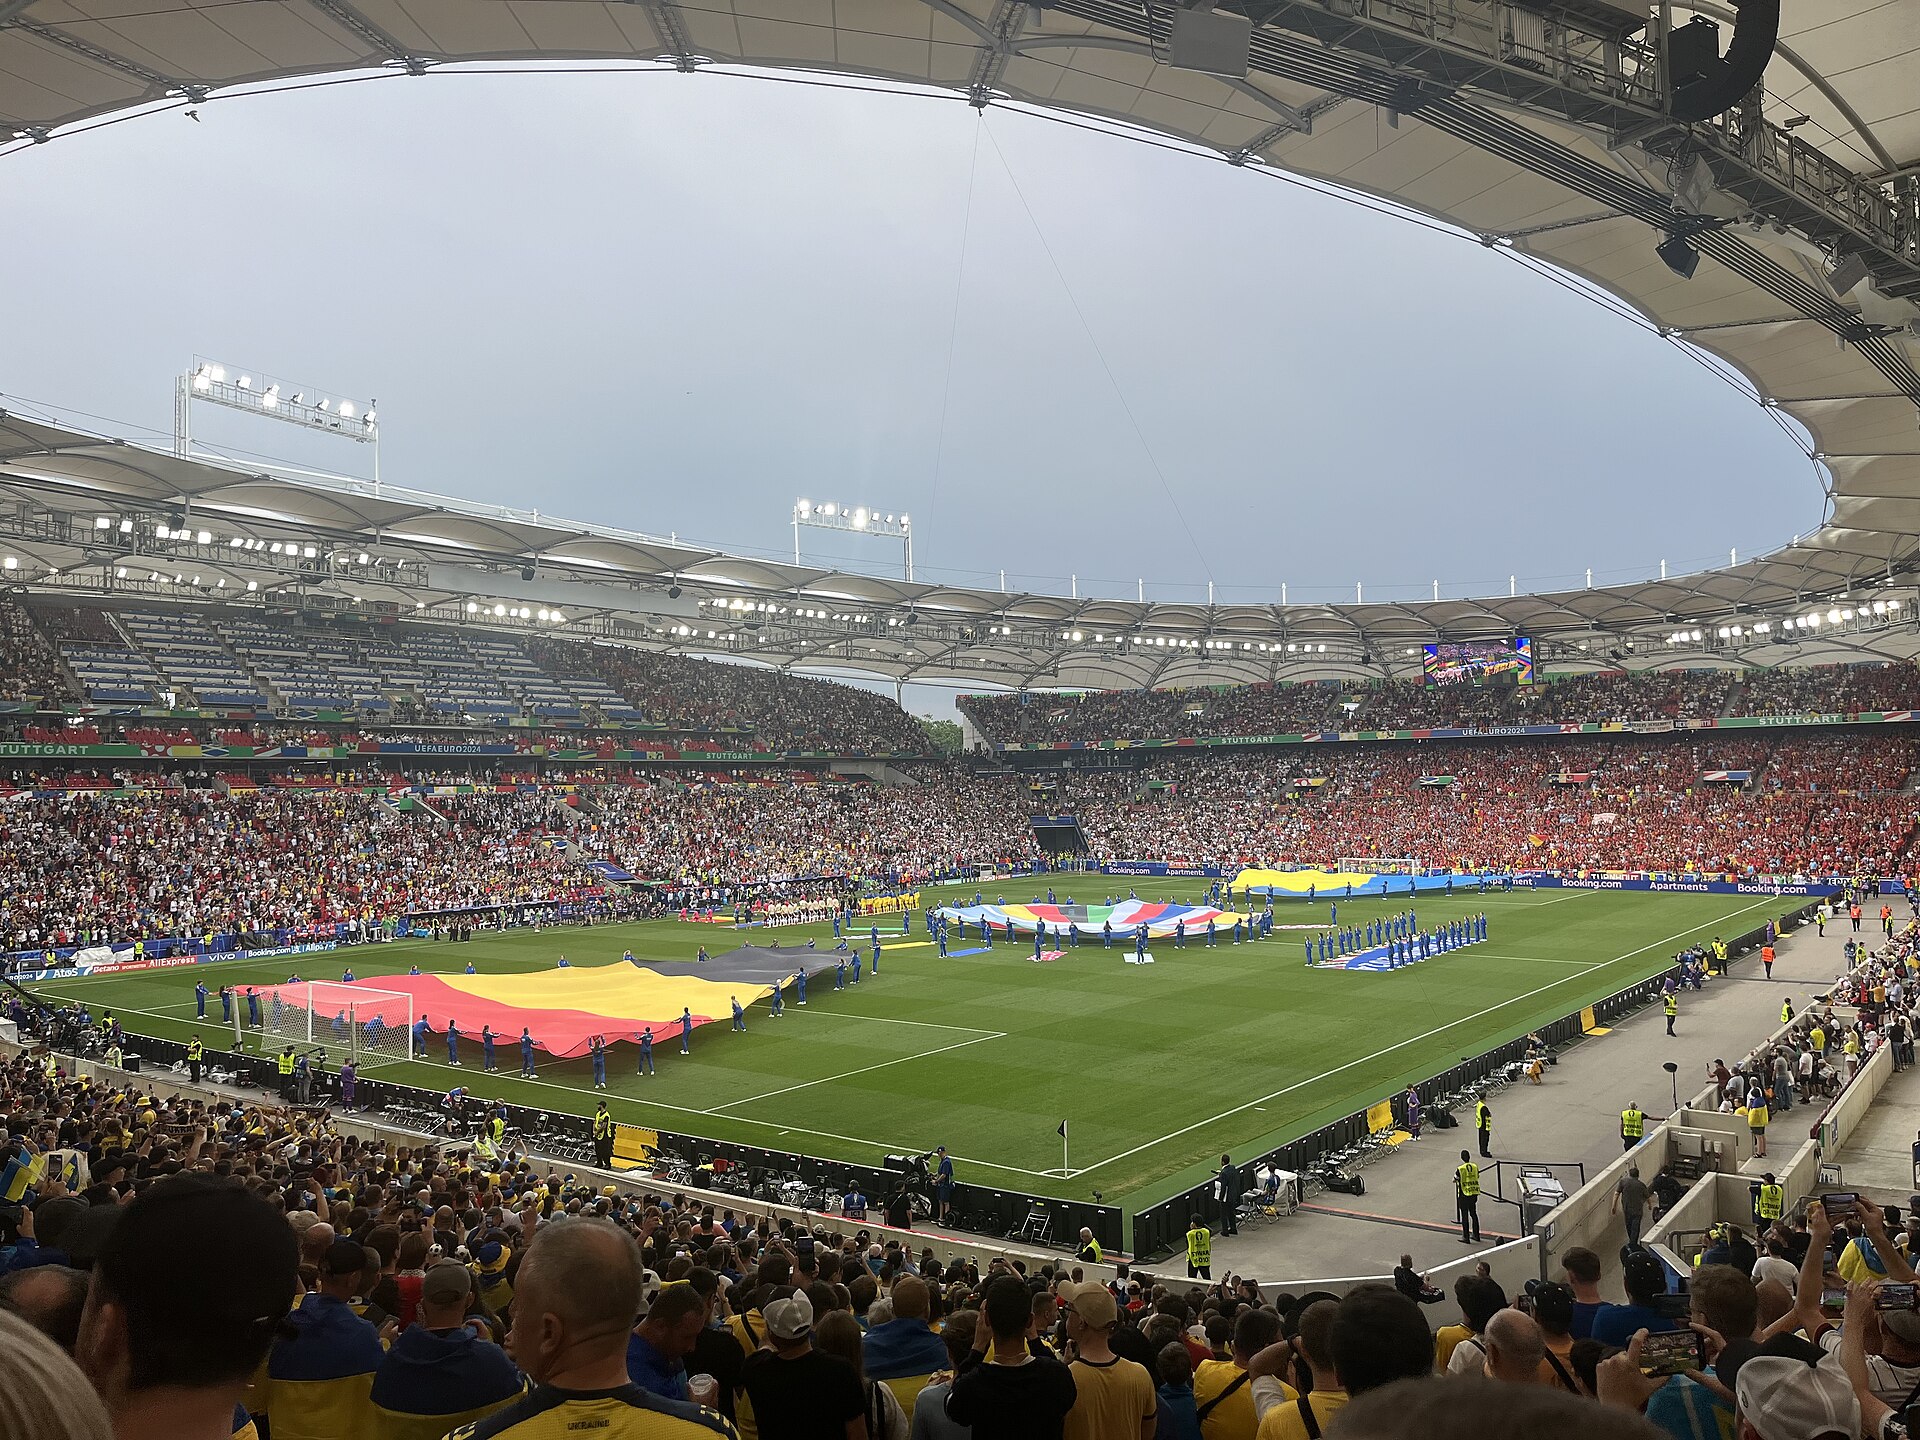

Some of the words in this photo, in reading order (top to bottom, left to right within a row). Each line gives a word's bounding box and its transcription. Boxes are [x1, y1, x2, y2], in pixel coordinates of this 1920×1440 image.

[1759, 715, 1839, 725] STUTTGART
[1221, 736, 1274, 744] STUTTGART
[706, 752, 753, 760] STUTTGART
[1108, 866, 1151, 875] Booking.com
[1165, 868, 1205, 876] Apartments
[1562, 878, 1622, 889] Booking.com
[1649, 882, 1709, 891] Apartments
[1737, 883, 1807, 894] Booking.com
[248, 947, 291, 958] Booking.com
[149, 957, 196, 967] AliExpress
[208, 953, 236, 962] vivo
[92, 965, 120, 973] Betano
